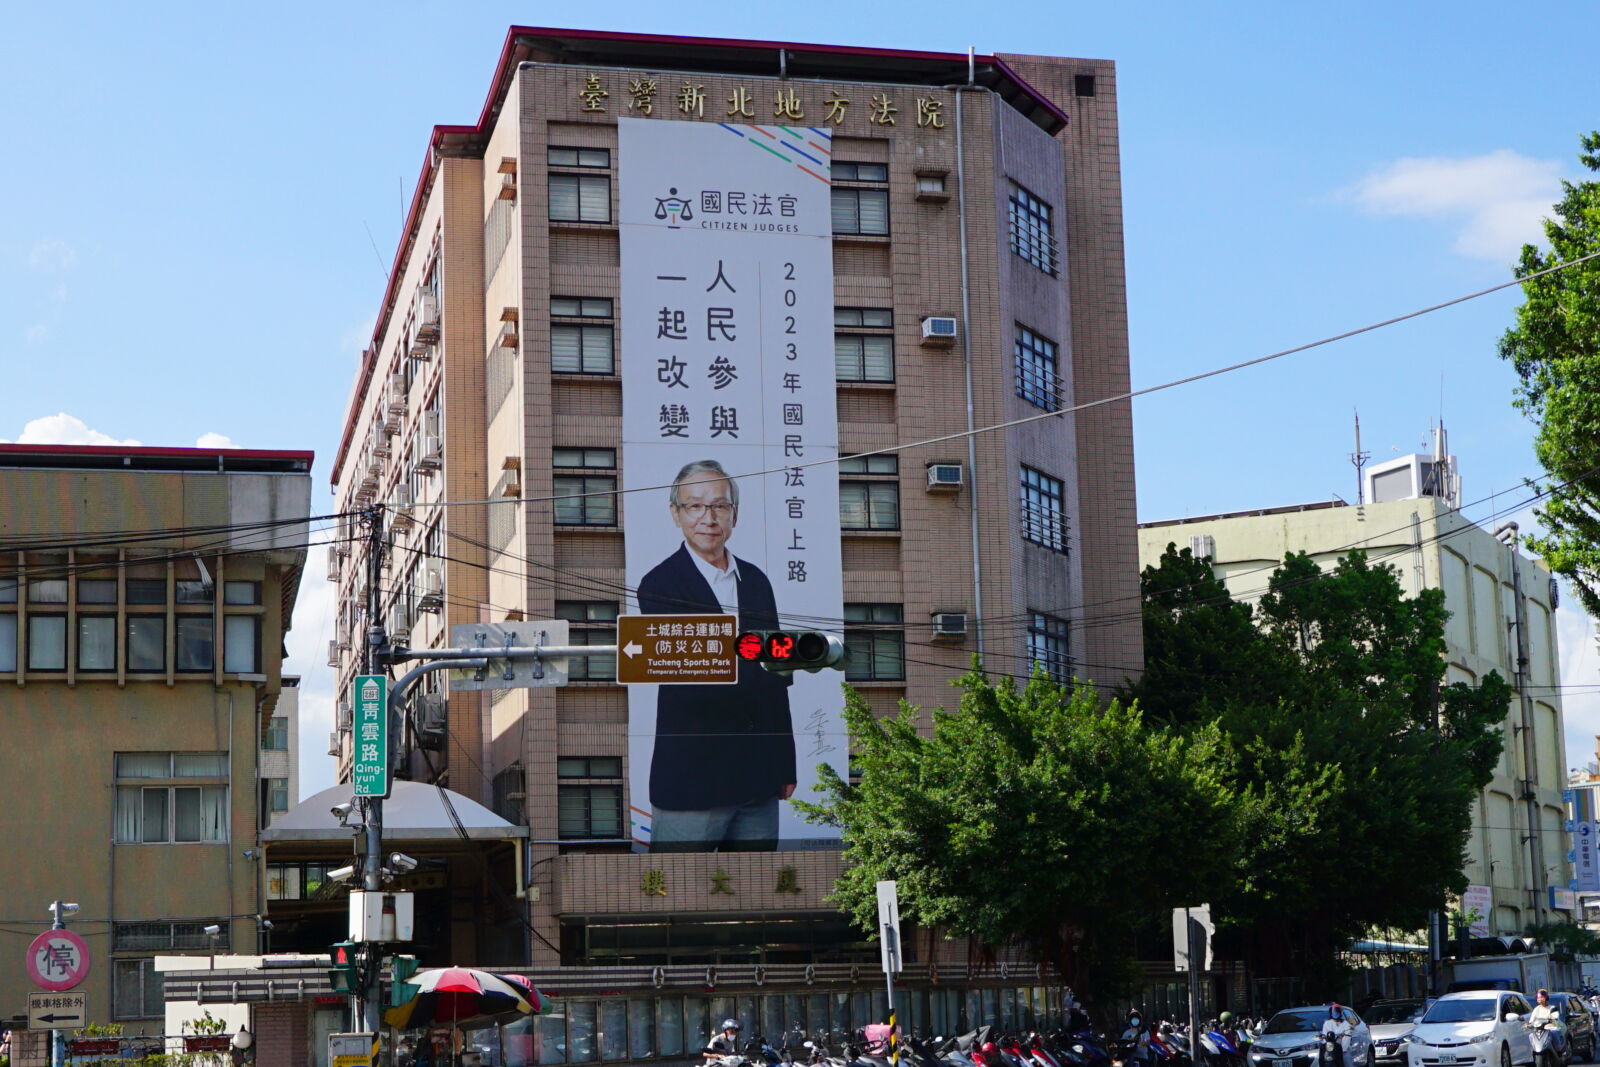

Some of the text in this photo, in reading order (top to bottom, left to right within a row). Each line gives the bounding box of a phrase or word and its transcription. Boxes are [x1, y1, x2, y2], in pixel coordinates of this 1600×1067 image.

[579, 73, 945, 129] 臺灣新北地方法院
[701, 190, 798, 217] 國民法官
[701, 220, 799, 232] CITIZEN JUDGES
[657, 275, 690, 438] 一起改變
[706, 259, 739, 439] 人民參與
[783, 262, 807, 582] 2023年國民法官上路
[646, 623, 733, 637] 土城綜合運動場
[655, 639, 723, 655] (防災公園)
[647, 658, 731, 668] Tucheng Sports Park
[355, 763, 385, 775] Qing-
[356, 775, 376, 785] yun
[355, 784, 372, 794] Rd.
[42, 944, 74, 976] 停
